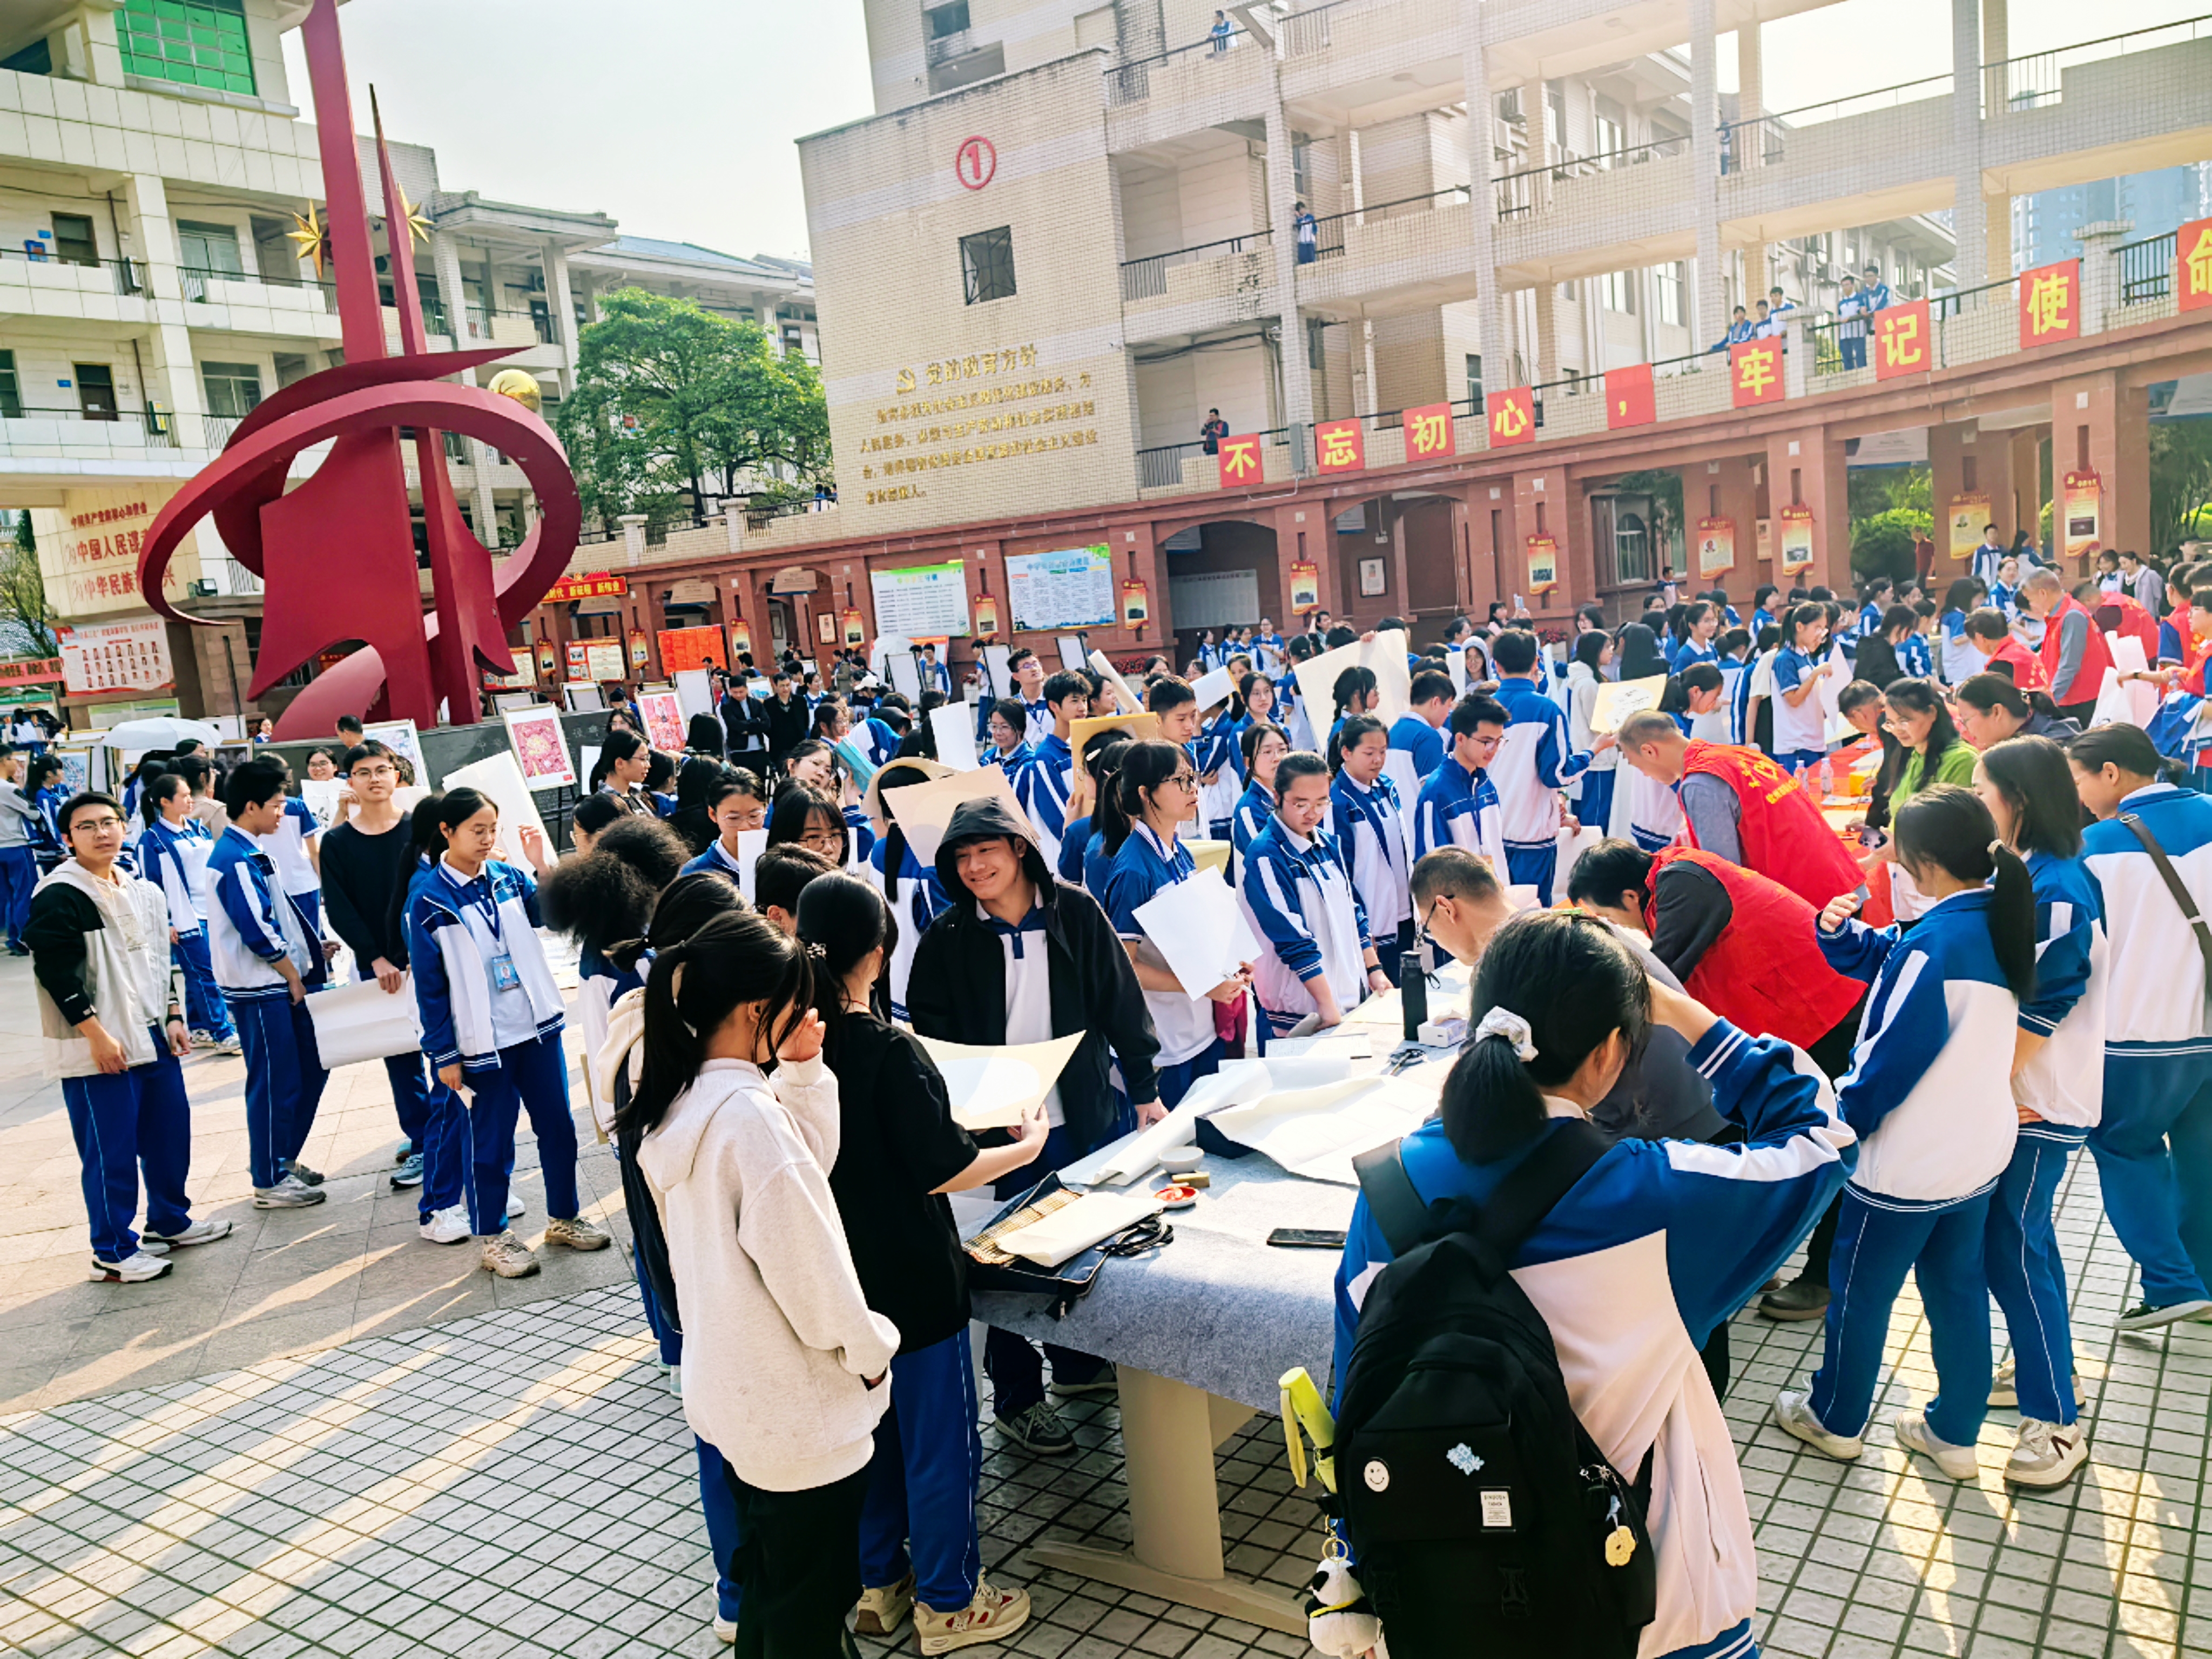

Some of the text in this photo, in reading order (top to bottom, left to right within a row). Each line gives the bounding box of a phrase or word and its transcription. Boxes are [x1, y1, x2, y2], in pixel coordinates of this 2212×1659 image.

[926, 343, 1037, 386] 党的教育方针
[1224, 442, 1256, 478] 不
[1322, 428, 1357, 466] 忘
[1411, 414, 1447, 454] 初
[1494, 398, 1528, 437] 心
[1738, 348, 1776, 396] 牢
[1881, 314, 1922, 367] 记
[2026, 273, 2070, 336] 使
[65, 529, 147, 566] 为中国人民谋
[569, 584, 592, 597] 新征程
[597, 581, 620, 594] 新伟业
